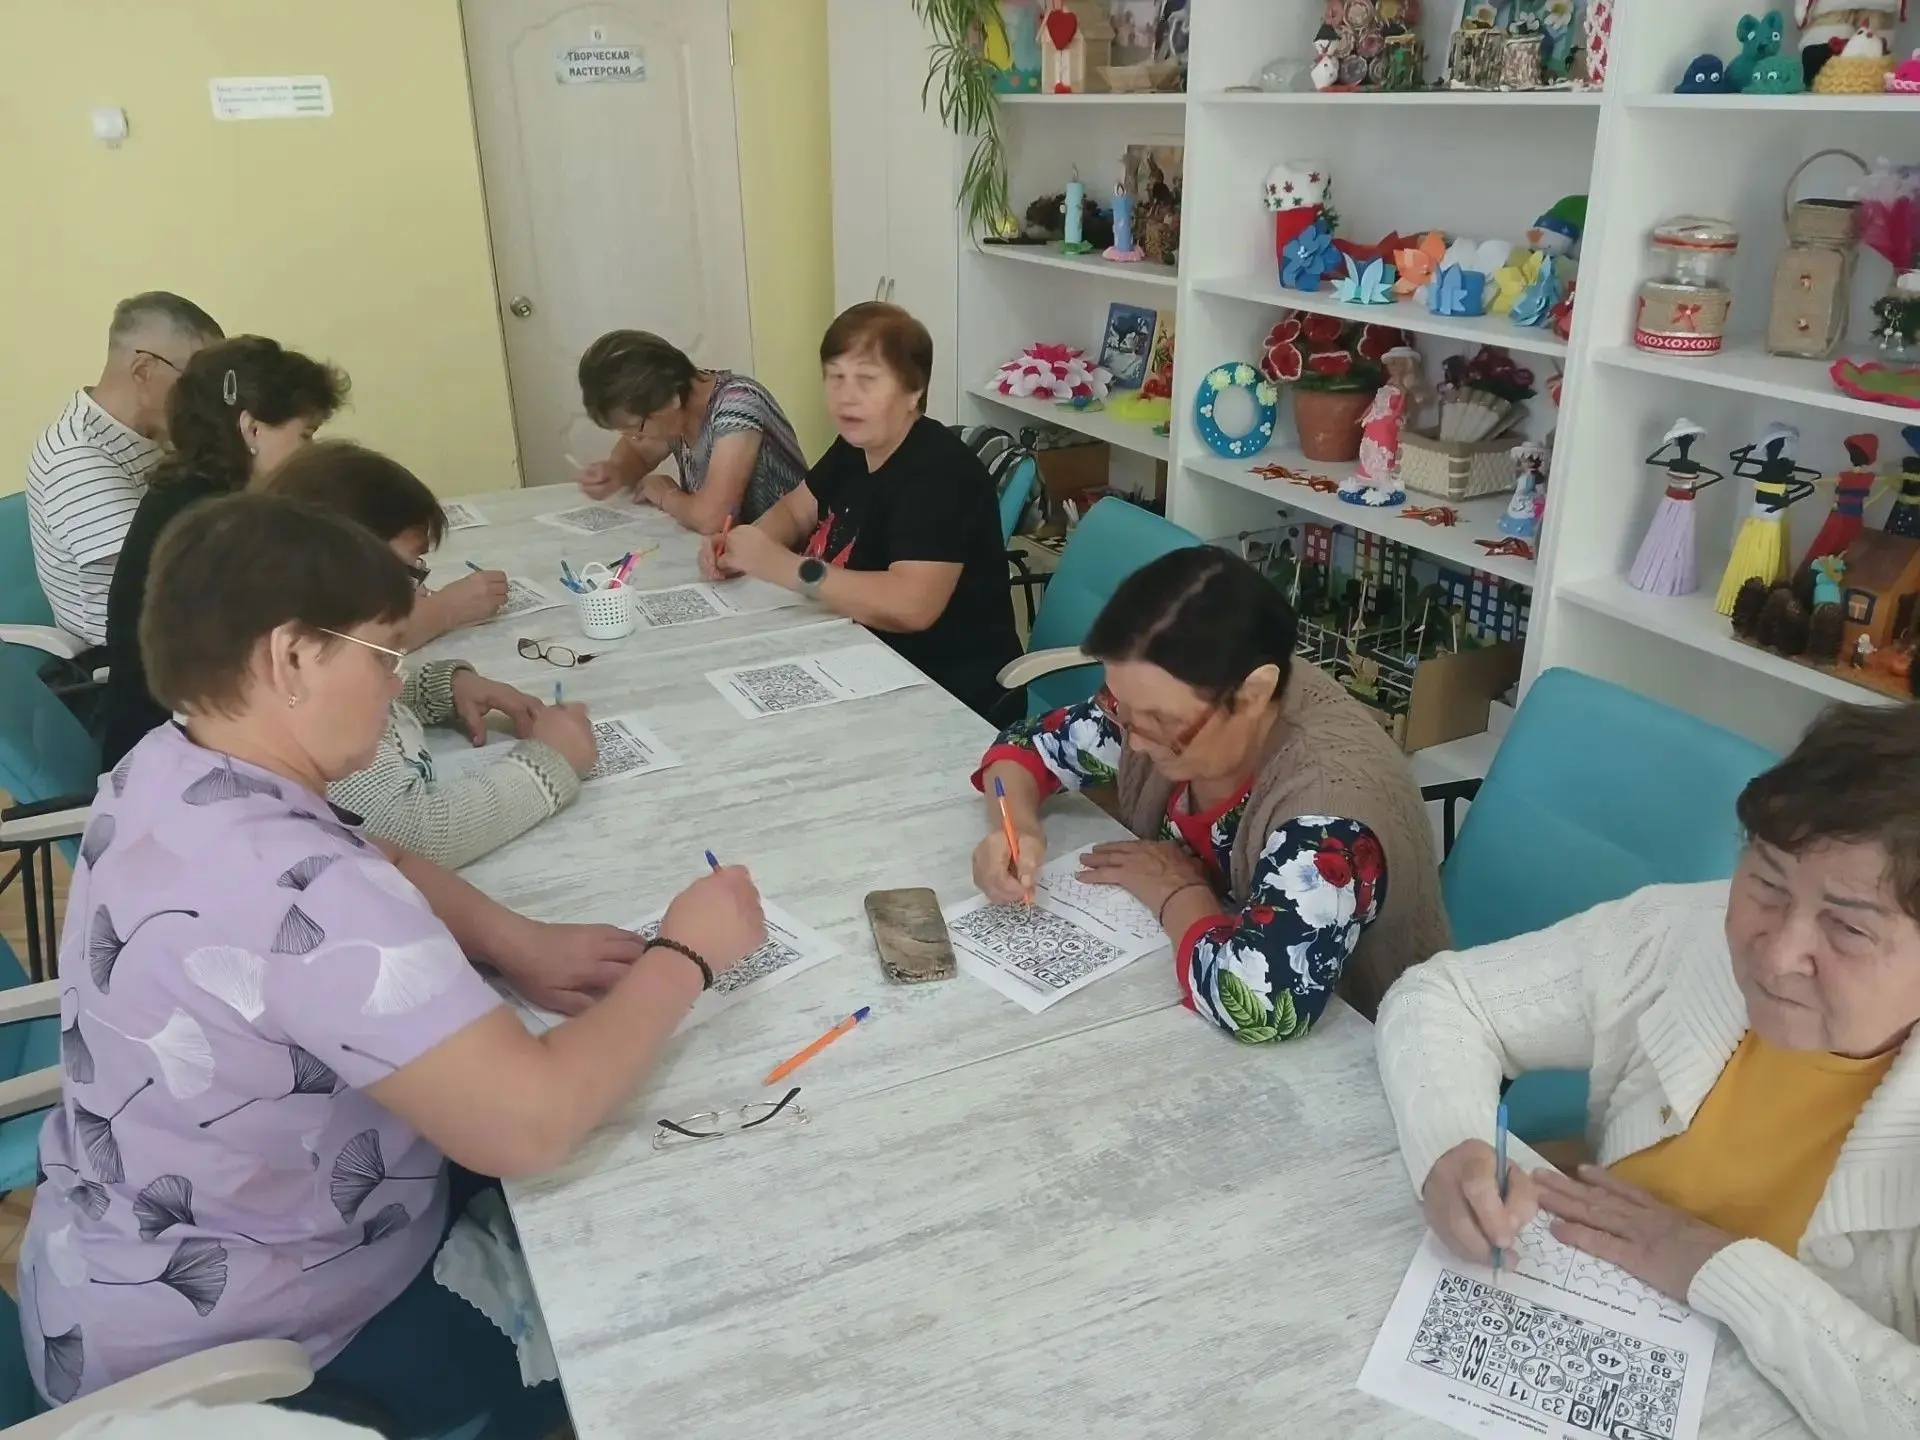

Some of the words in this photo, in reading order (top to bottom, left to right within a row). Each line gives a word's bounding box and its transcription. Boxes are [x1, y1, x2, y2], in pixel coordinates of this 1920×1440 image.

[567, 50, 630, 62] ТВОРЧЕСКАЯ
[568, 66, 631, 77] МАСТЕРСКАЯ
[1451, 1275, 1469, 1292] 90
[1472, 1283, 1490, 1300] 19
[1480, 1314, 1504, 1331] 58
[1514, 1310, 1531, 1333] 22
[1509, 1338, 1531, 1354] 49
[1623, 1336, 1642, 1350] 83
[1460, 1333, 1489, 1381] 63
[1596, 1352, 1621, 1369] 46
[1649, 1349, 1666, 1364] 50
[1566, 1359, 1585, 1372] 28
[1649, 1362, 1672, 1379] 89
[1480, 1371, 1500, 1389] 79
[1533, 1362, 1551, 1388] 23
[1508, 1381, 1530, 1401] 11
[1639, 1393, 1658, 1406] 76
[1540, 1396, 1566, 1415] 33
